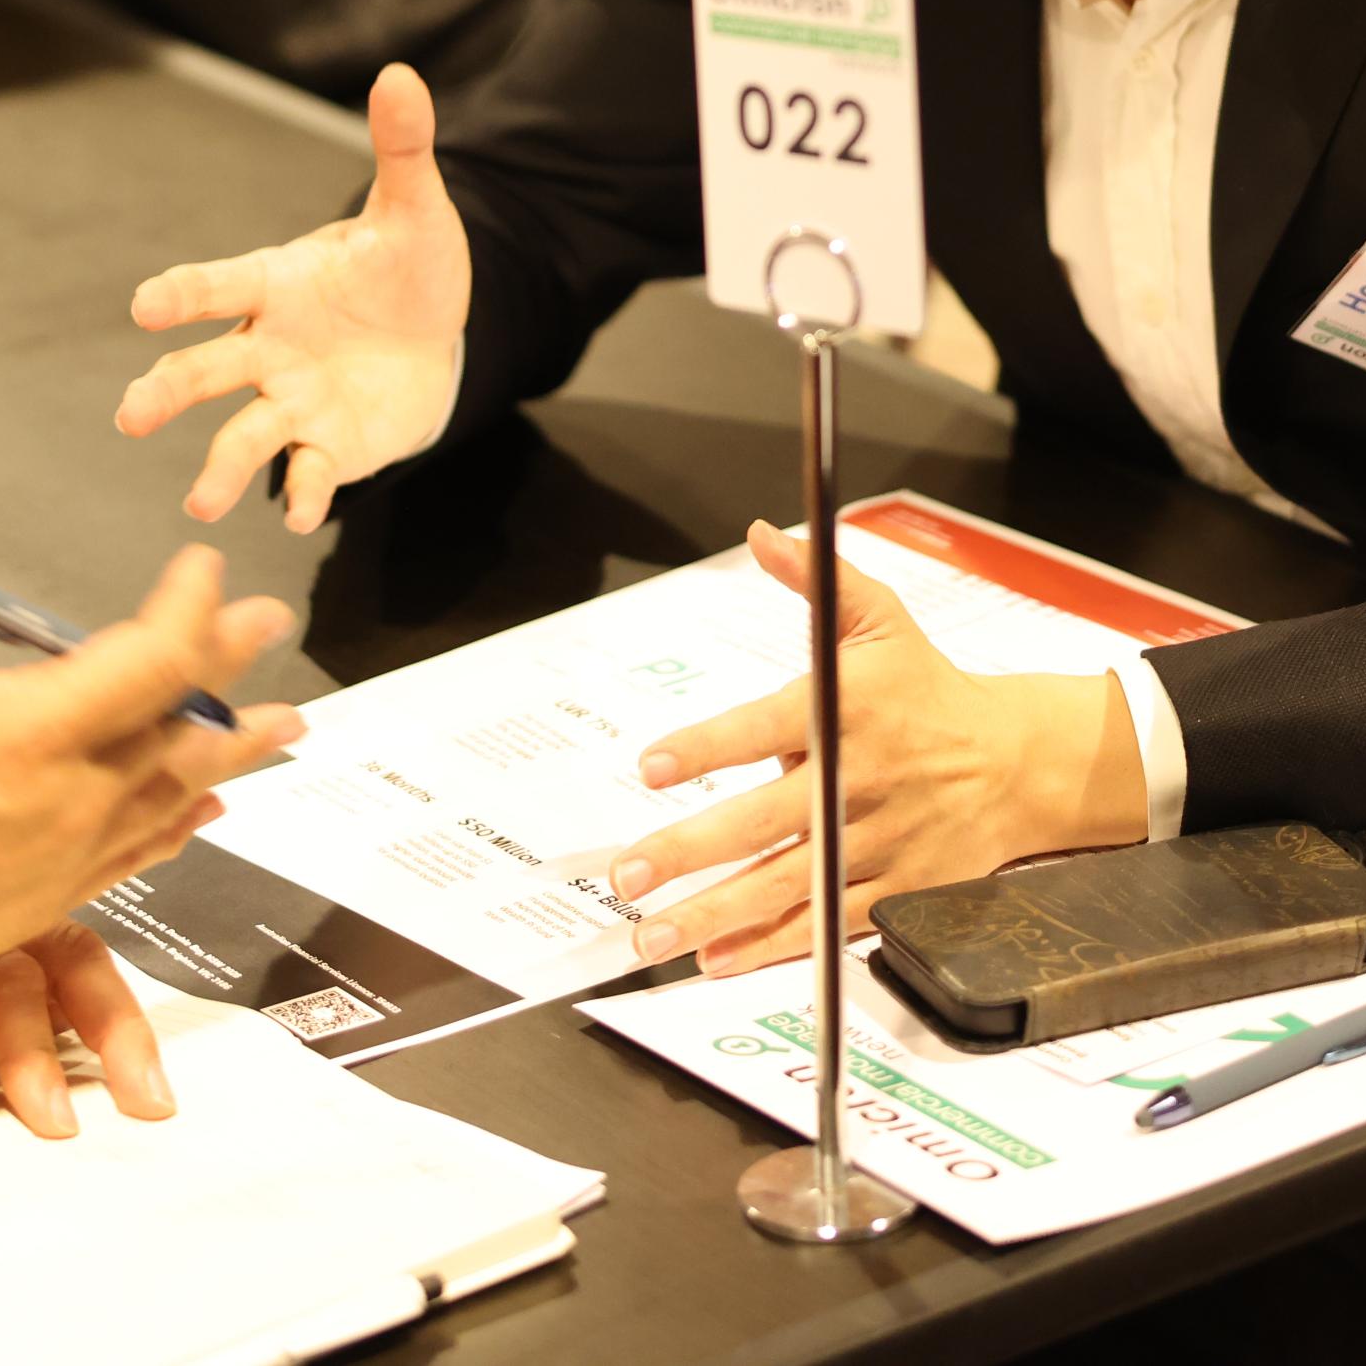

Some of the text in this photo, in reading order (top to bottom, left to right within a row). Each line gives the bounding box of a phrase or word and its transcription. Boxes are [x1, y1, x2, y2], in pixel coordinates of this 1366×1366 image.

[738, 83, 870, 165] 022
[381, 772, 436, 803] Months
[457, 817, 543, 866] $50 Million
[567, 877, 600, 895] $4+
[166, 946, 200, 971] Brighton
[254, 923, 292, 947] Australian
[287, 943, 323, 965] Financial
[317, 962, 349, 982] Services
[766, 1013, 1045, 1167] commercial moage
[783, 1065, 999, 1182] Omicrn
